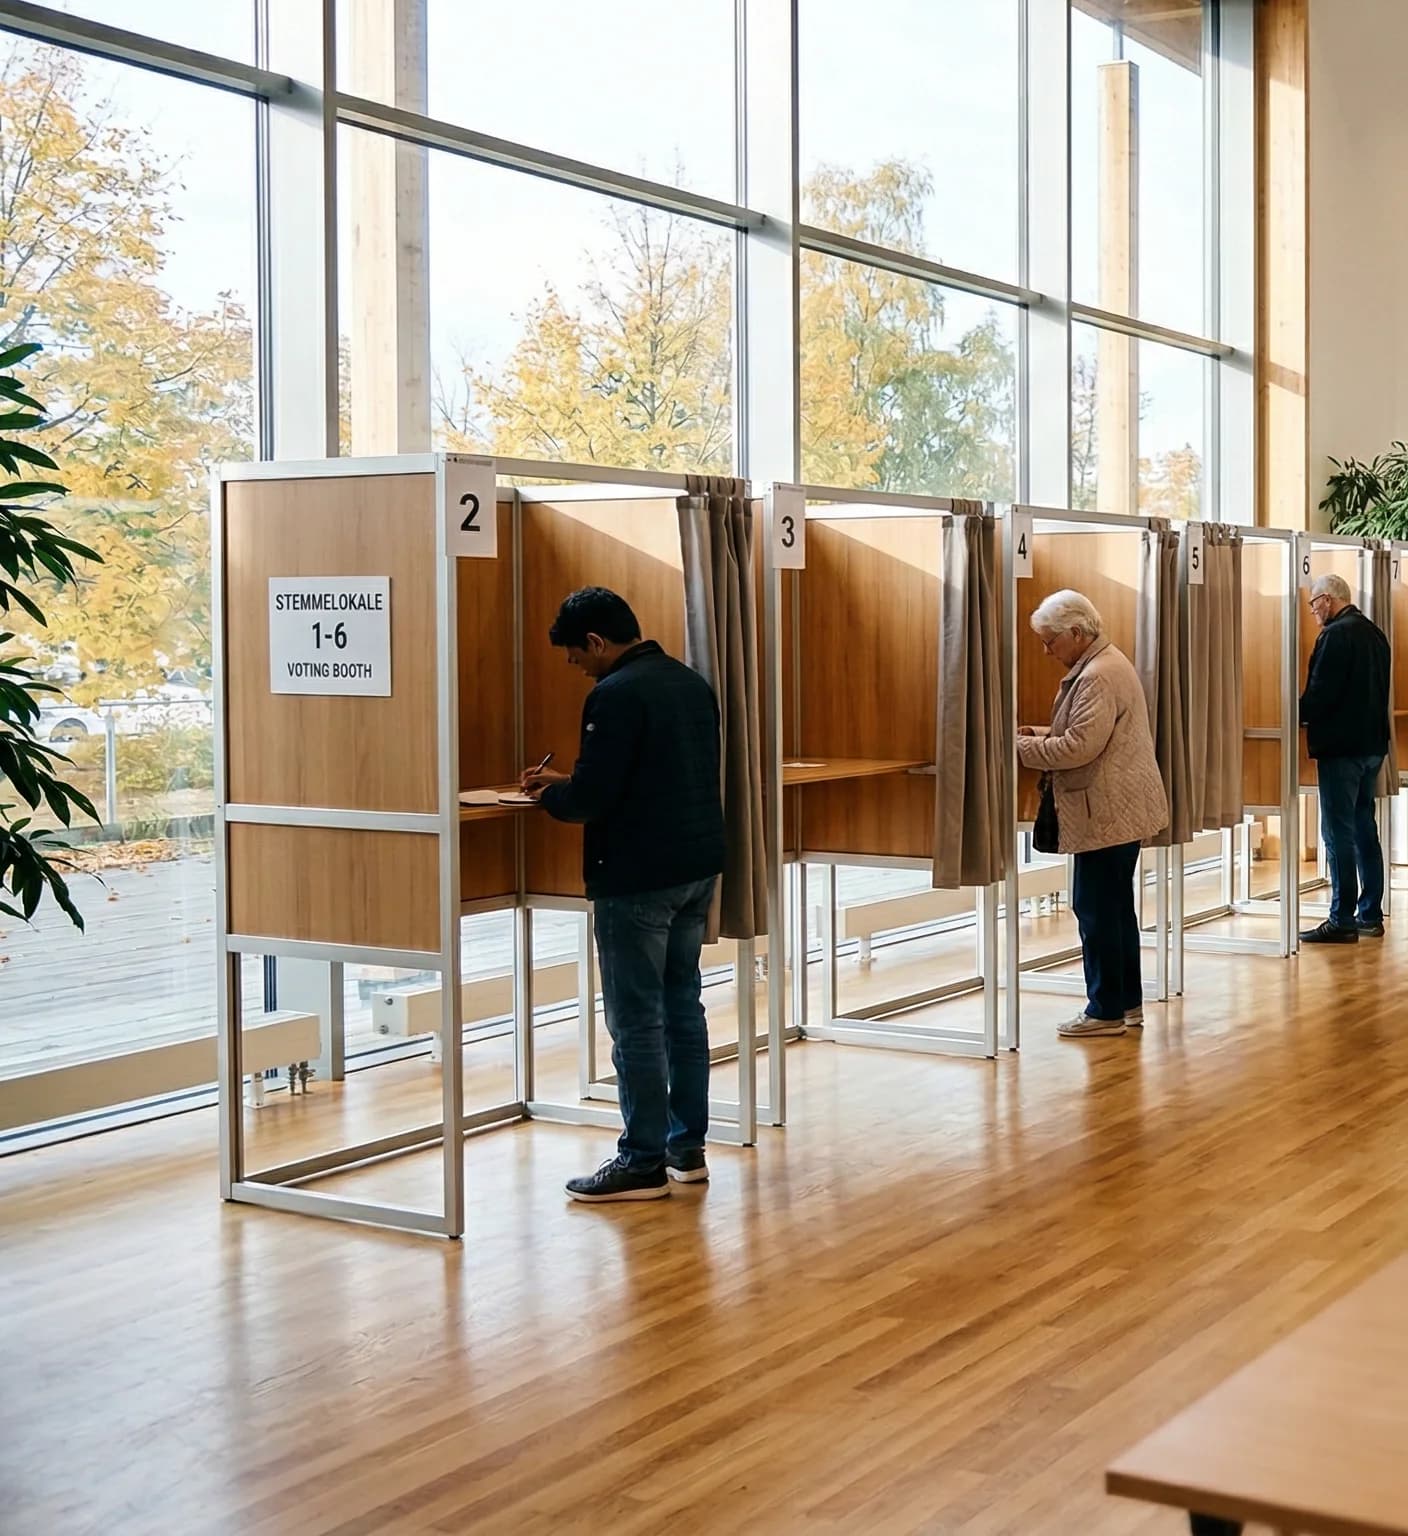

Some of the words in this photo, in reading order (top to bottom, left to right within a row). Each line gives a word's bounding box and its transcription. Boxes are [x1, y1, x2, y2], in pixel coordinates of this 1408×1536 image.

[460, 493, 481, 532] 2
[781, 515, 795, 548] 3
[1017, 532, 1028, 560] 4
[1191, 547, 1200, 570] 5
[1302, 555, 1310, 575] 6
[1392, 560, 1399, 579] 7
[275, 593, 383, 611] STEMMELOKALE
[312, 621, 348, 649] 1-6
[287, 662, 330, 678] VOTING
[332, 663, 372, 679] BOOTH
